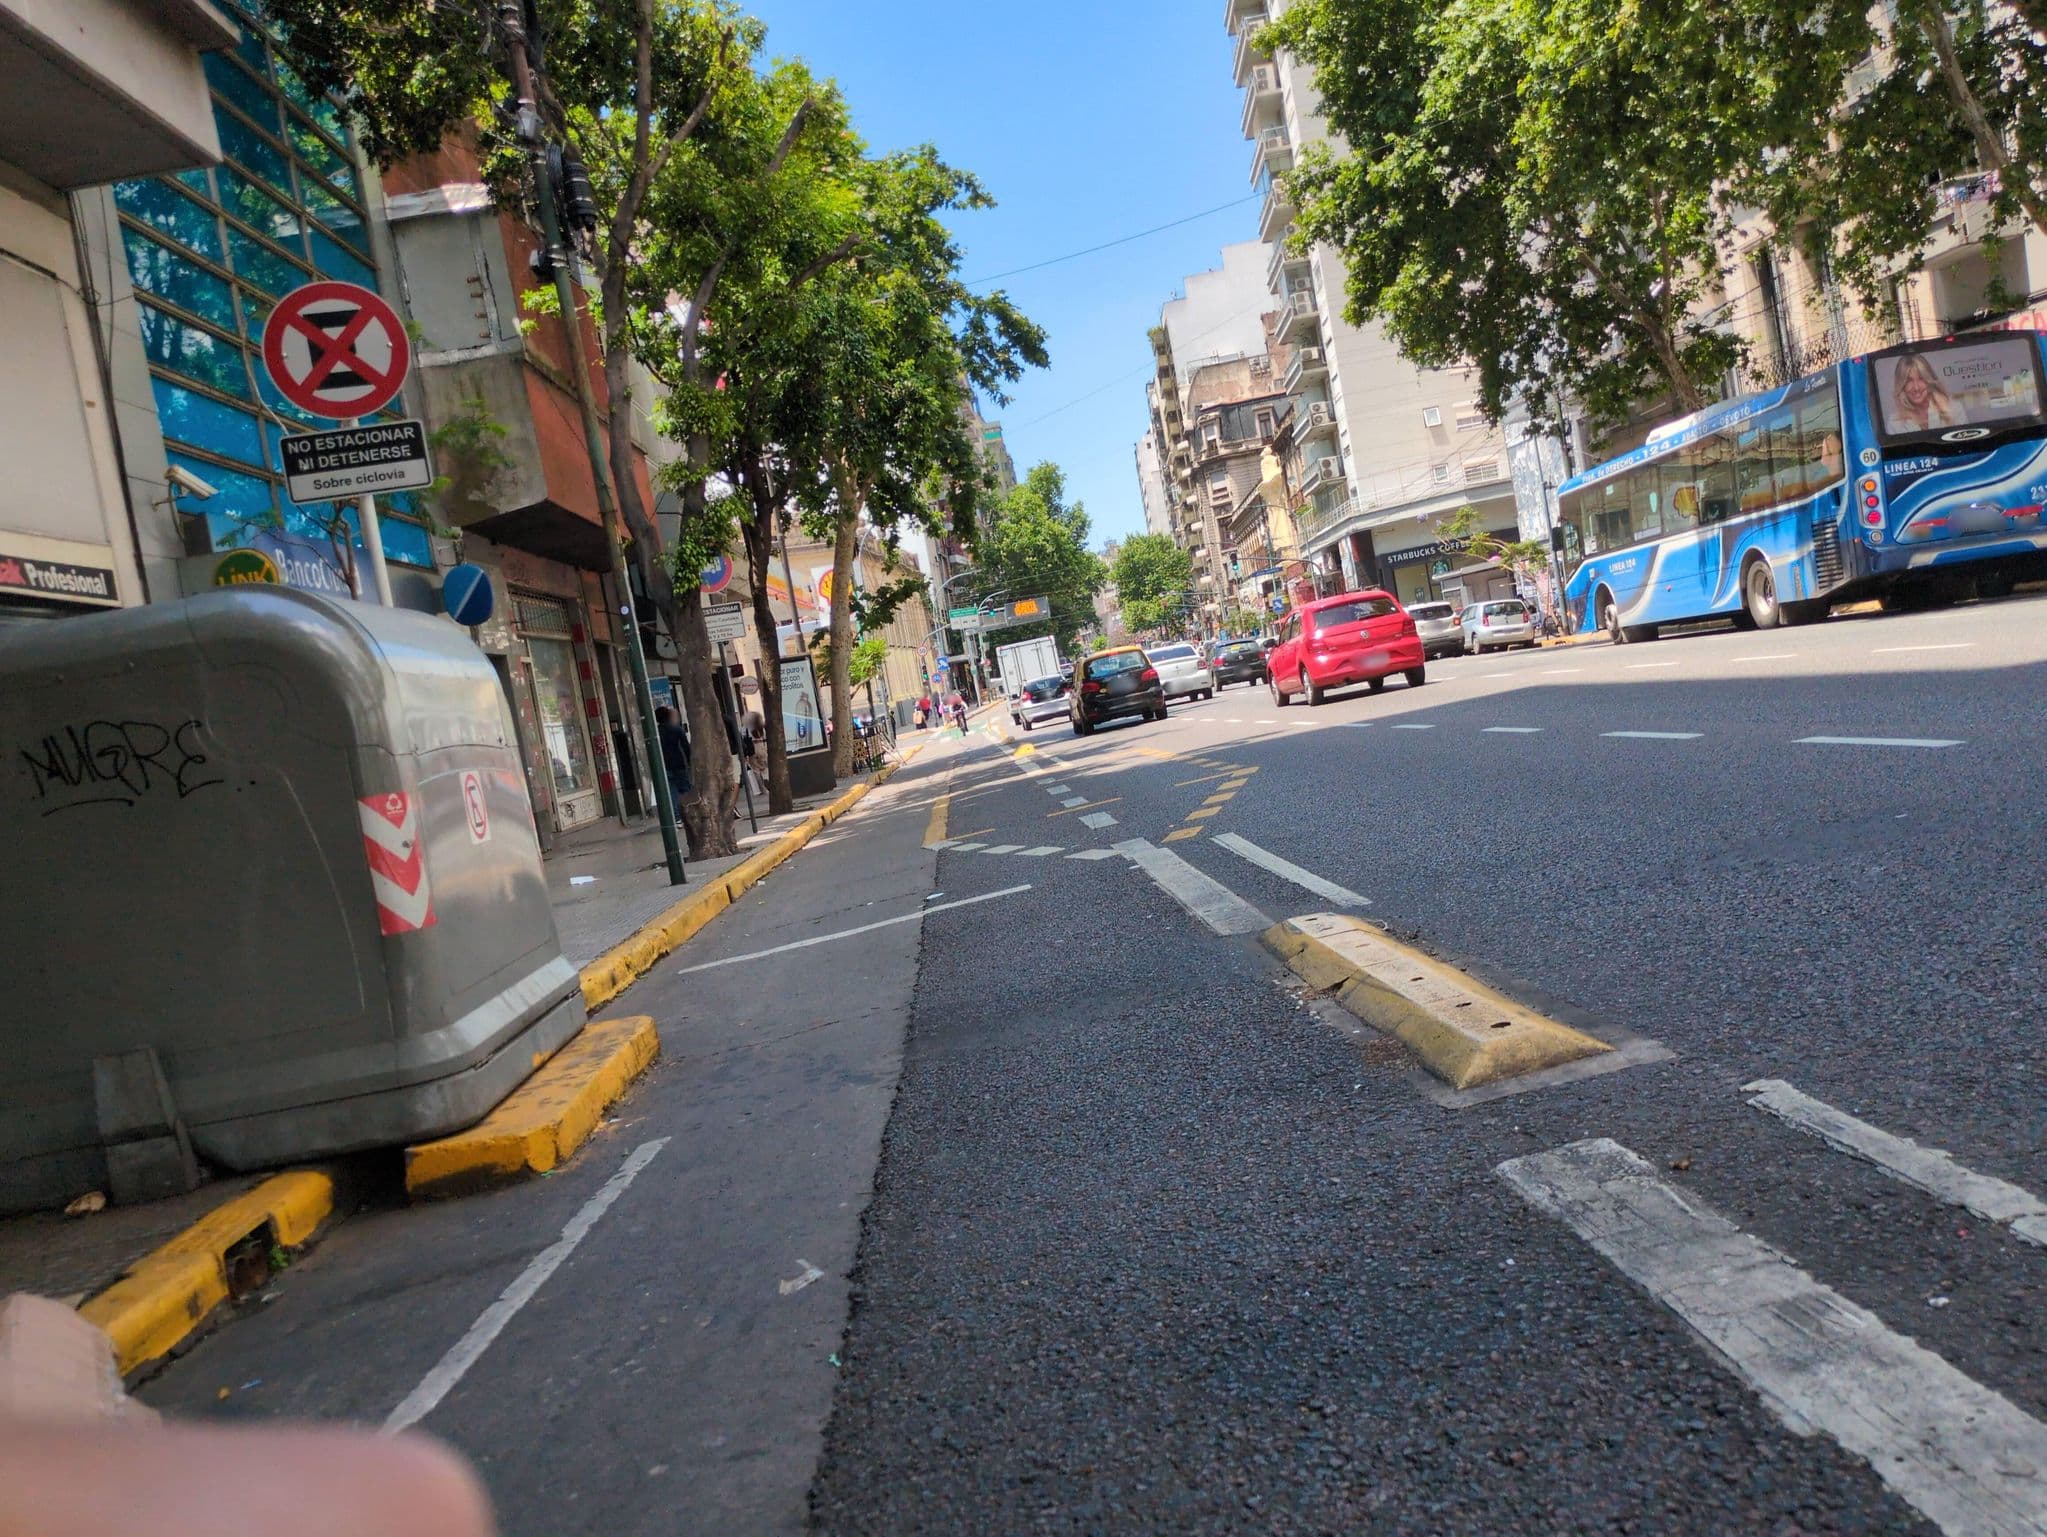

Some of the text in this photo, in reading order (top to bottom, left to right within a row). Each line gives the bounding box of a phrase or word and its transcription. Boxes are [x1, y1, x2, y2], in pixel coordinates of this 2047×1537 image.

[1943, 360, 2002, 377] Question
[287, 427, 415, 455] NO ESTACIONAR
[298, 444, 412, 471] NI DETENERSE
[1605, 456, 1634, 475] DERECHO
[1643, 440, 1670, 459] 124
[1863, 451, 1877, 463] 60
[1884, 461, 1917, 474] LINEA
[1920, 457, 1938, 469] 124
[313, 476, 352, 490] Sobre
[1387, 546, 1436, 564] STARBUCKS
[24, 562, 108, 596] Profesional
